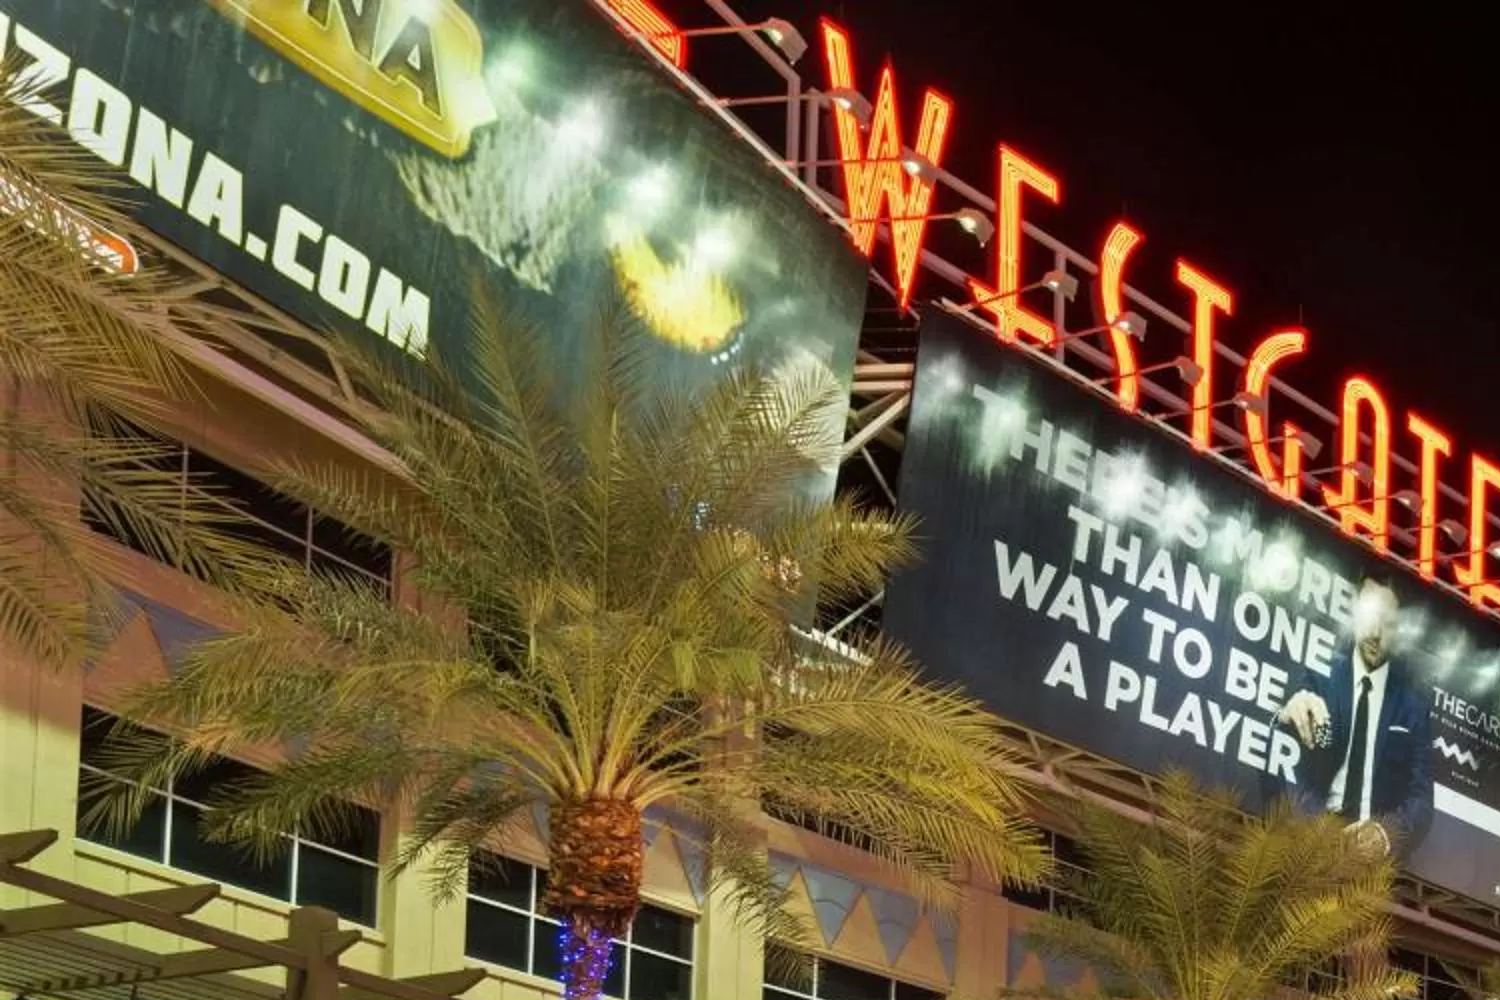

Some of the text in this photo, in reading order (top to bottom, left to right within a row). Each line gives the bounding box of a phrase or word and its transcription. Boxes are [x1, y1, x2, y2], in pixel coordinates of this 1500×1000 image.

[993, 539, 1289, 713] WAY TO BE
[1066, 505, 1337, 679] THAN ONE
[1042, 640, 1301, 785] A PLAYER
